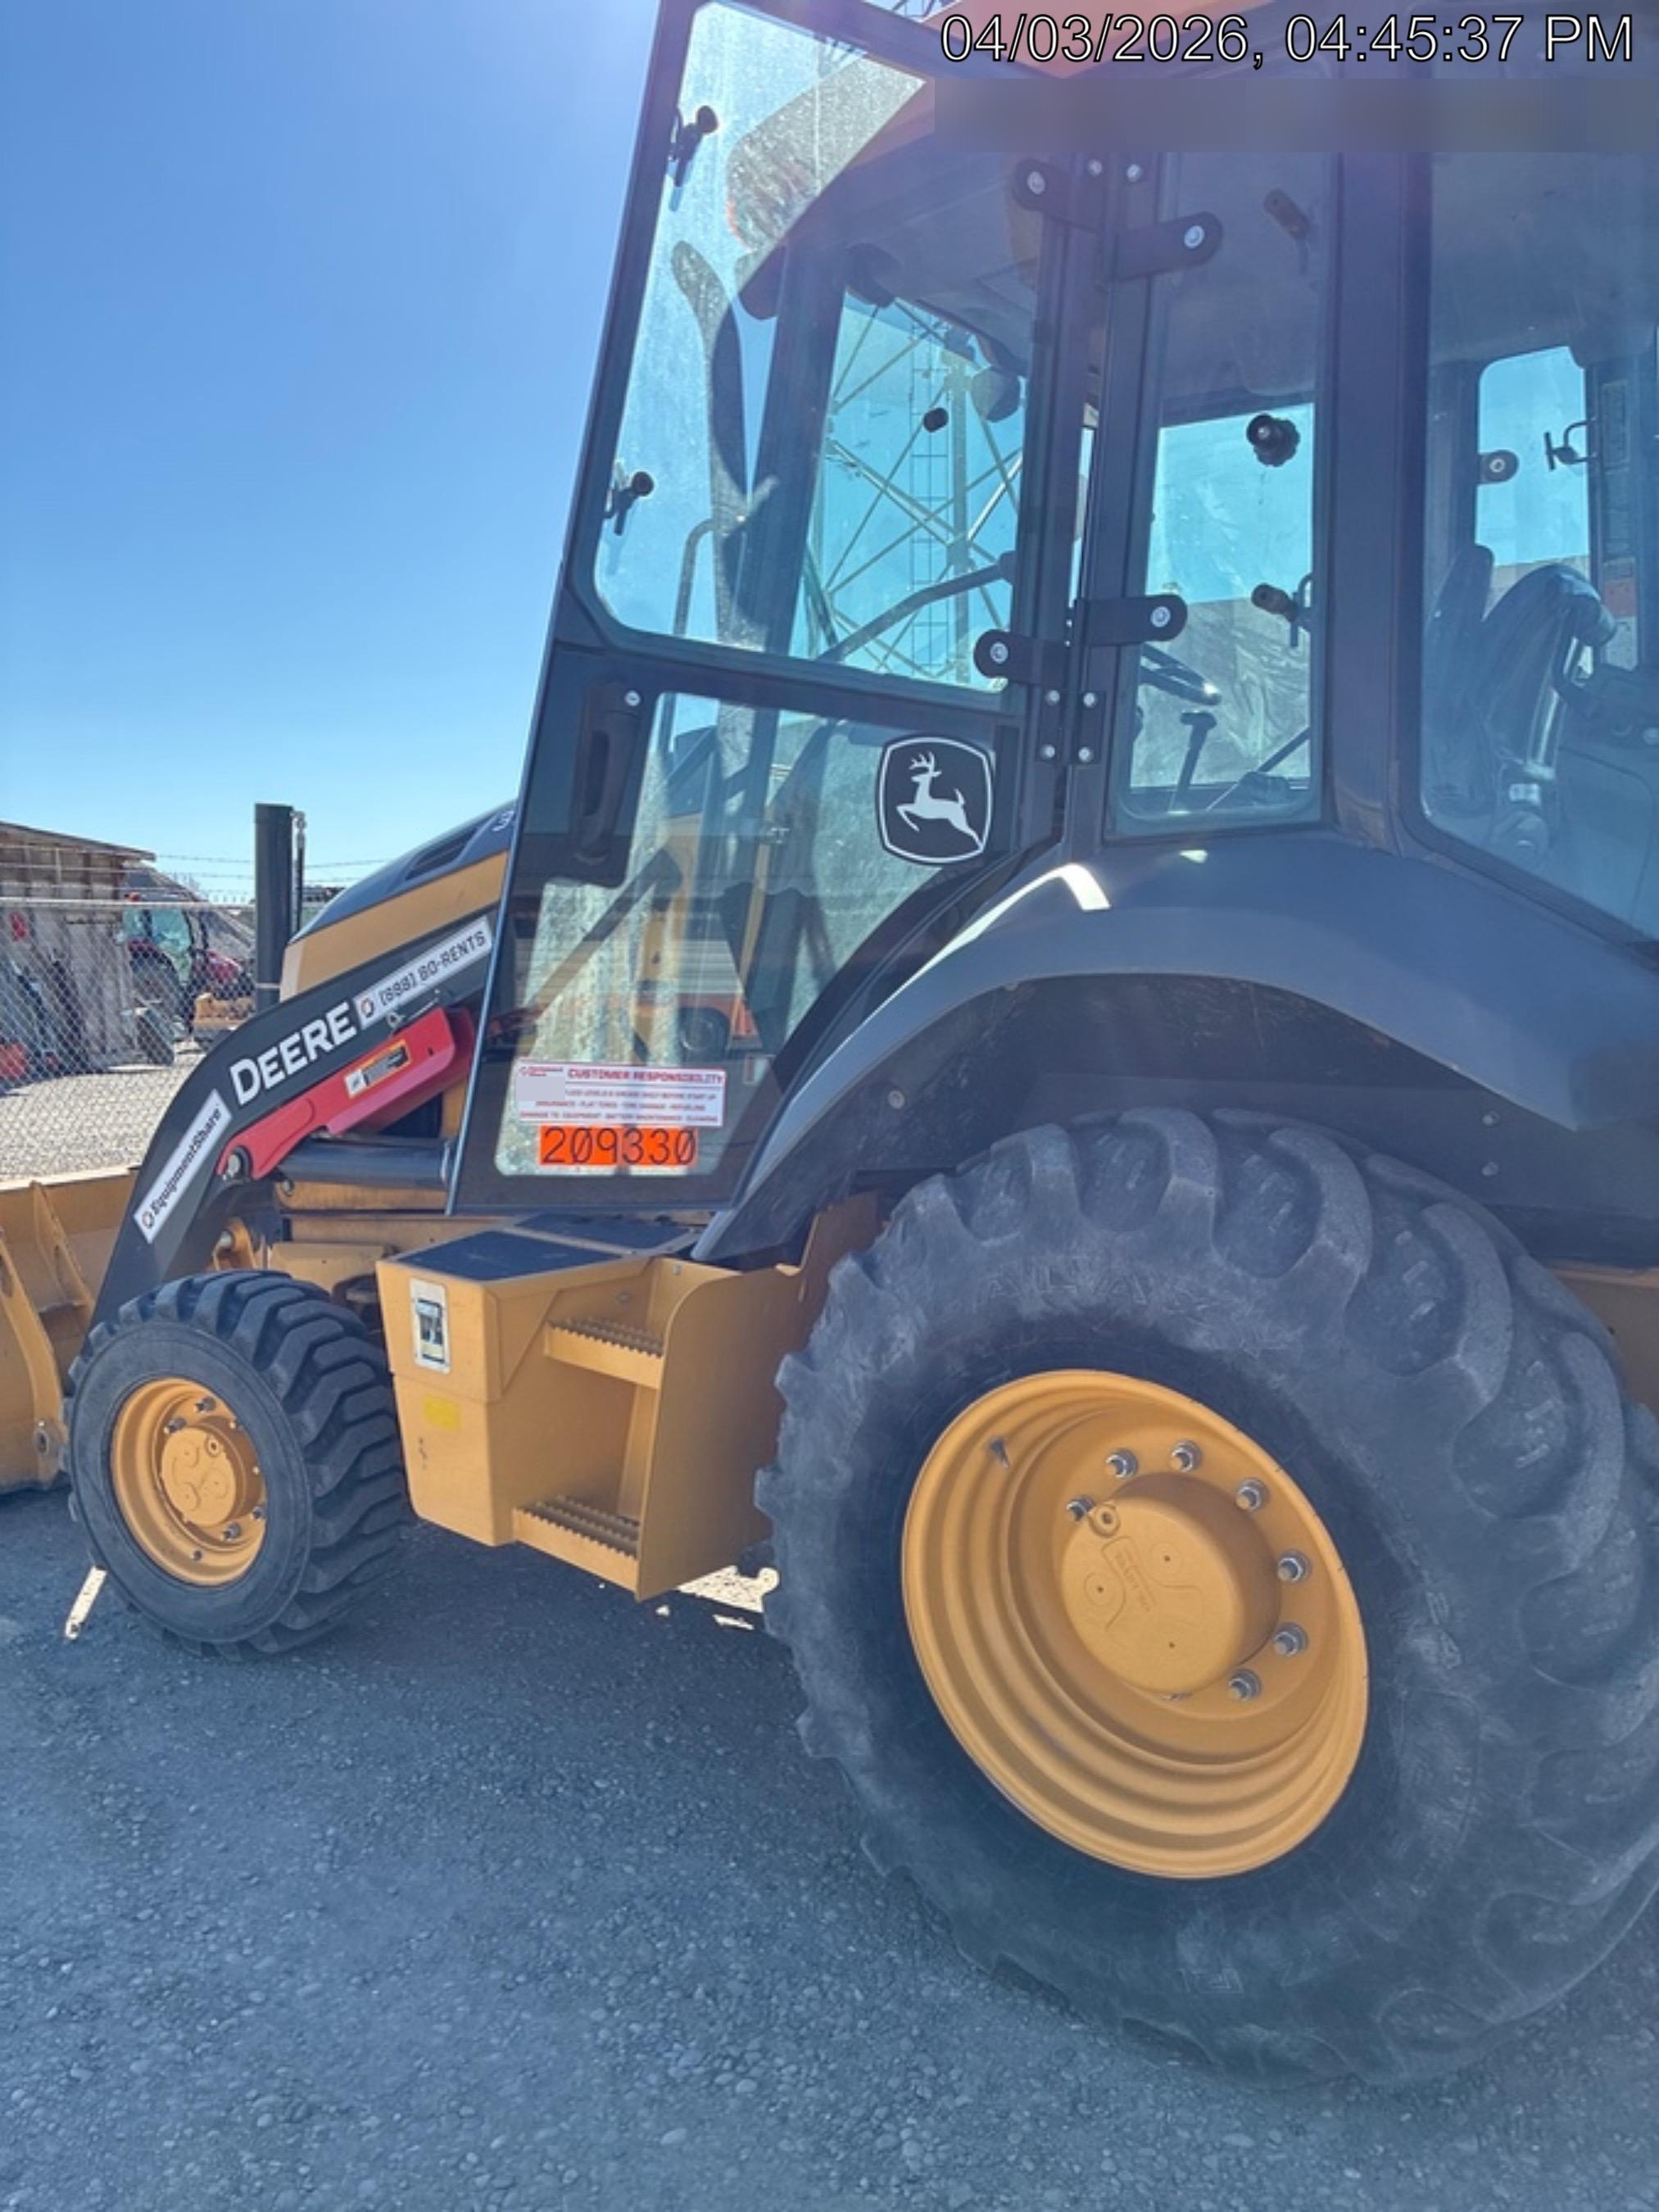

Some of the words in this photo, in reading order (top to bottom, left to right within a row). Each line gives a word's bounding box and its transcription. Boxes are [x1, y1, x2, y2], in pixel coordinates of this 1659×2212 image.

[230, 1002, 358, 1106] DEERE
[567, 1067, 630, 1081] CUSTOMER
[632, 1071, 723, 1084] RESPONSIBILITY
[542, 1127, 696, 1165] 209330
